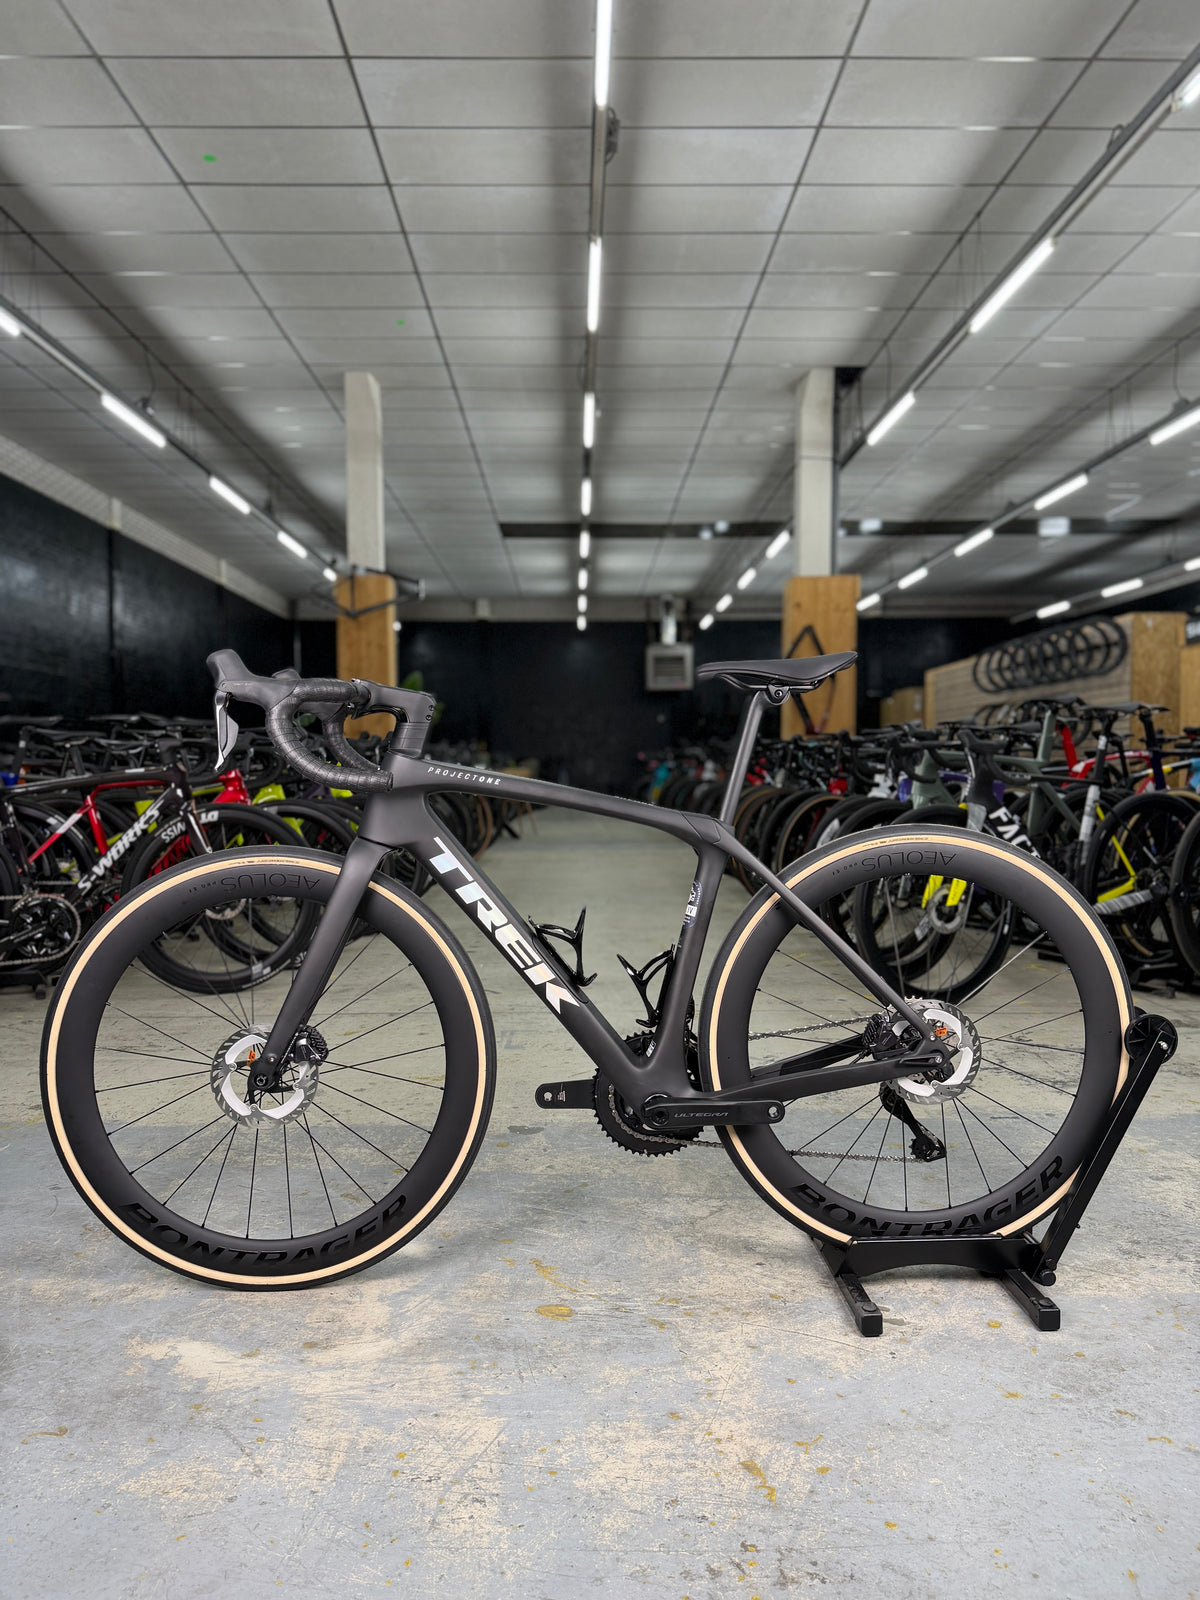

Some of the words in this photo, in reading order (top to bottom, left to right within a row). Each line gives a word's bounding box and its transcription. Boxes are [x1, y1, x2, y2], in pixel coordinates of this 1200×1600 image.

[861, 850, 957, 872] AEOLUS
[988, 806, 1042, 859] FACT
[220, 872, 321, 890] AEOLUS
[429, 836, 581, 1014] TREK
[789, 1154, 1064, 1236] BONTRAGER
[119, 1194, 408, 1266] BONTRAGER
